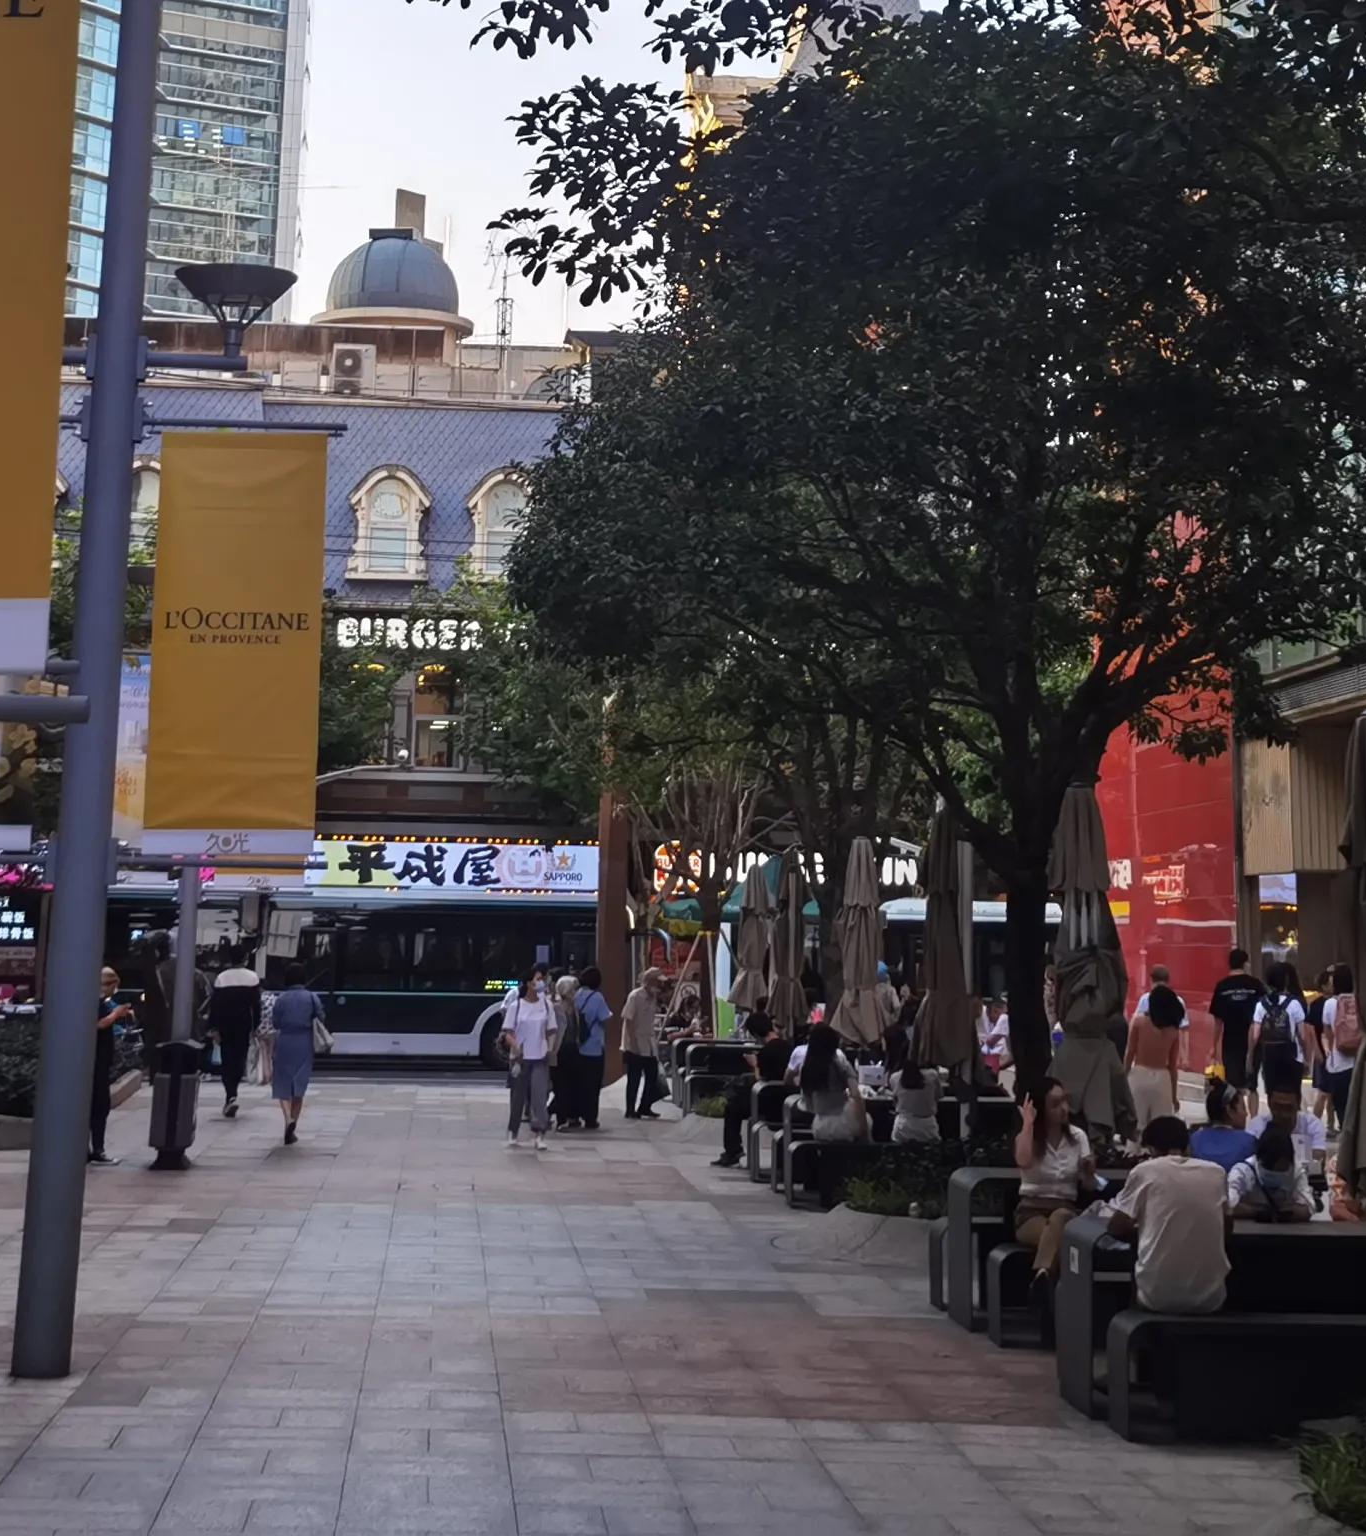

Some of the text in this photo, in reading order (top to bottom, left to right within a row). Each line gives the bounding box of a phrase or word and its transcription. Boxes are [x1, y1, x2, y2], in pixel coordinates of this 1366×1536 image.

[164, 607, 309, 632] L'OCCITANE
[190, 634, 281, 645] EN PROVENCE
[337, 617, 483, 651] BURGER
[339, 843, 502, 886] 平成屋
[543, 872, 583, 882] SAPPORO
